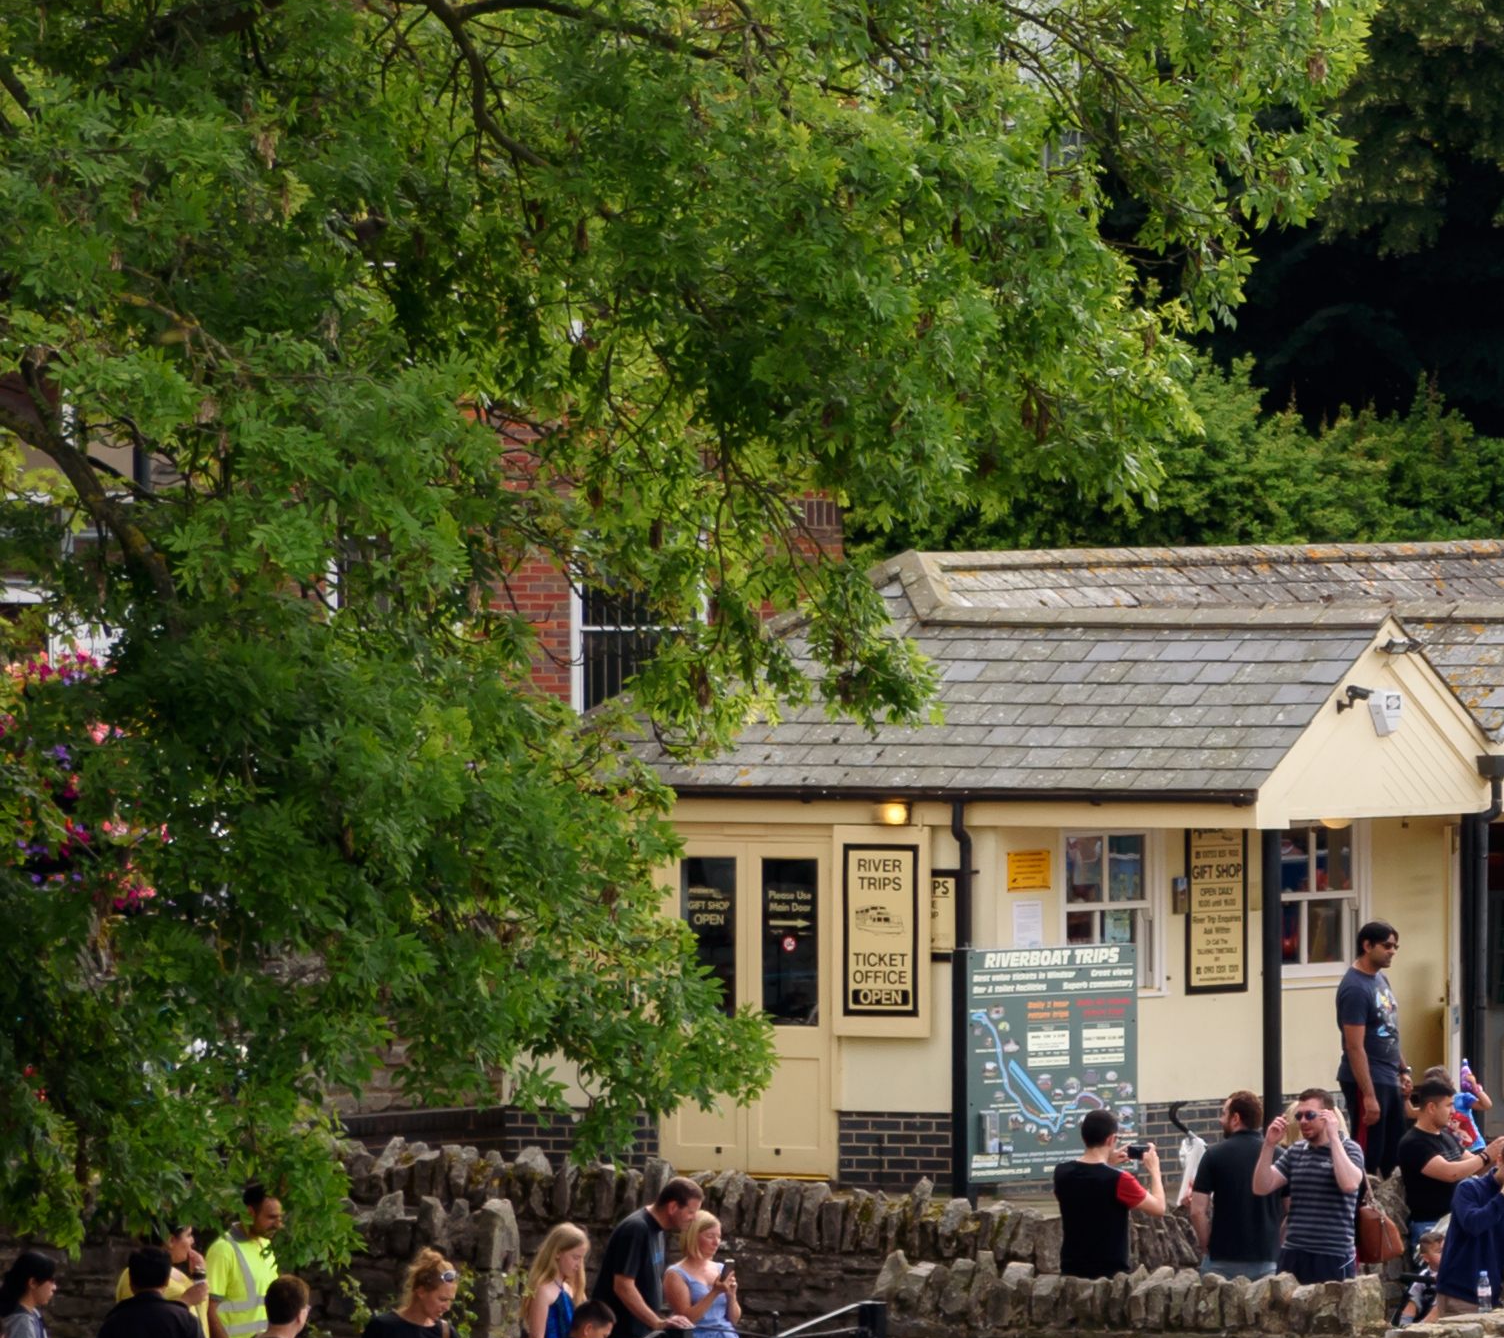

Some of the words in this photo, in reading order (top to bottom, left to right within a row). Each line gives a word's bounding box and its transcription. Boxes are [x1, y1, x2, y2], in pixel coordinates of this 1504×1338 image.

[857, 859, 902, 873] RIVER
[1192, 865, 1213, 880] GIFT
[1216, 863, 1242, 878] SHOP
[858, 877, 902, 891] TRIPS
[931, 880, 950, 896] PS
[768, 890, 795, 900] Please
[797, 890, 812, 900] Use
[688, 901, 705, 910] GIFT
[708, 901, 730, 910] SHOP
[769, 903, 790, 912] Main
[792, 903, 811, 912] Door
[693, 914, 725, 925] OPEN
[853, 953, 908, 967] TICKET
[984, 949, 1071, 969] RIVERBOAT
[1074, 947, 1120, 965] TRIPS
[853, 970, 907, 985] OFFICE
[860, 989, 902, 1004] OPEN
